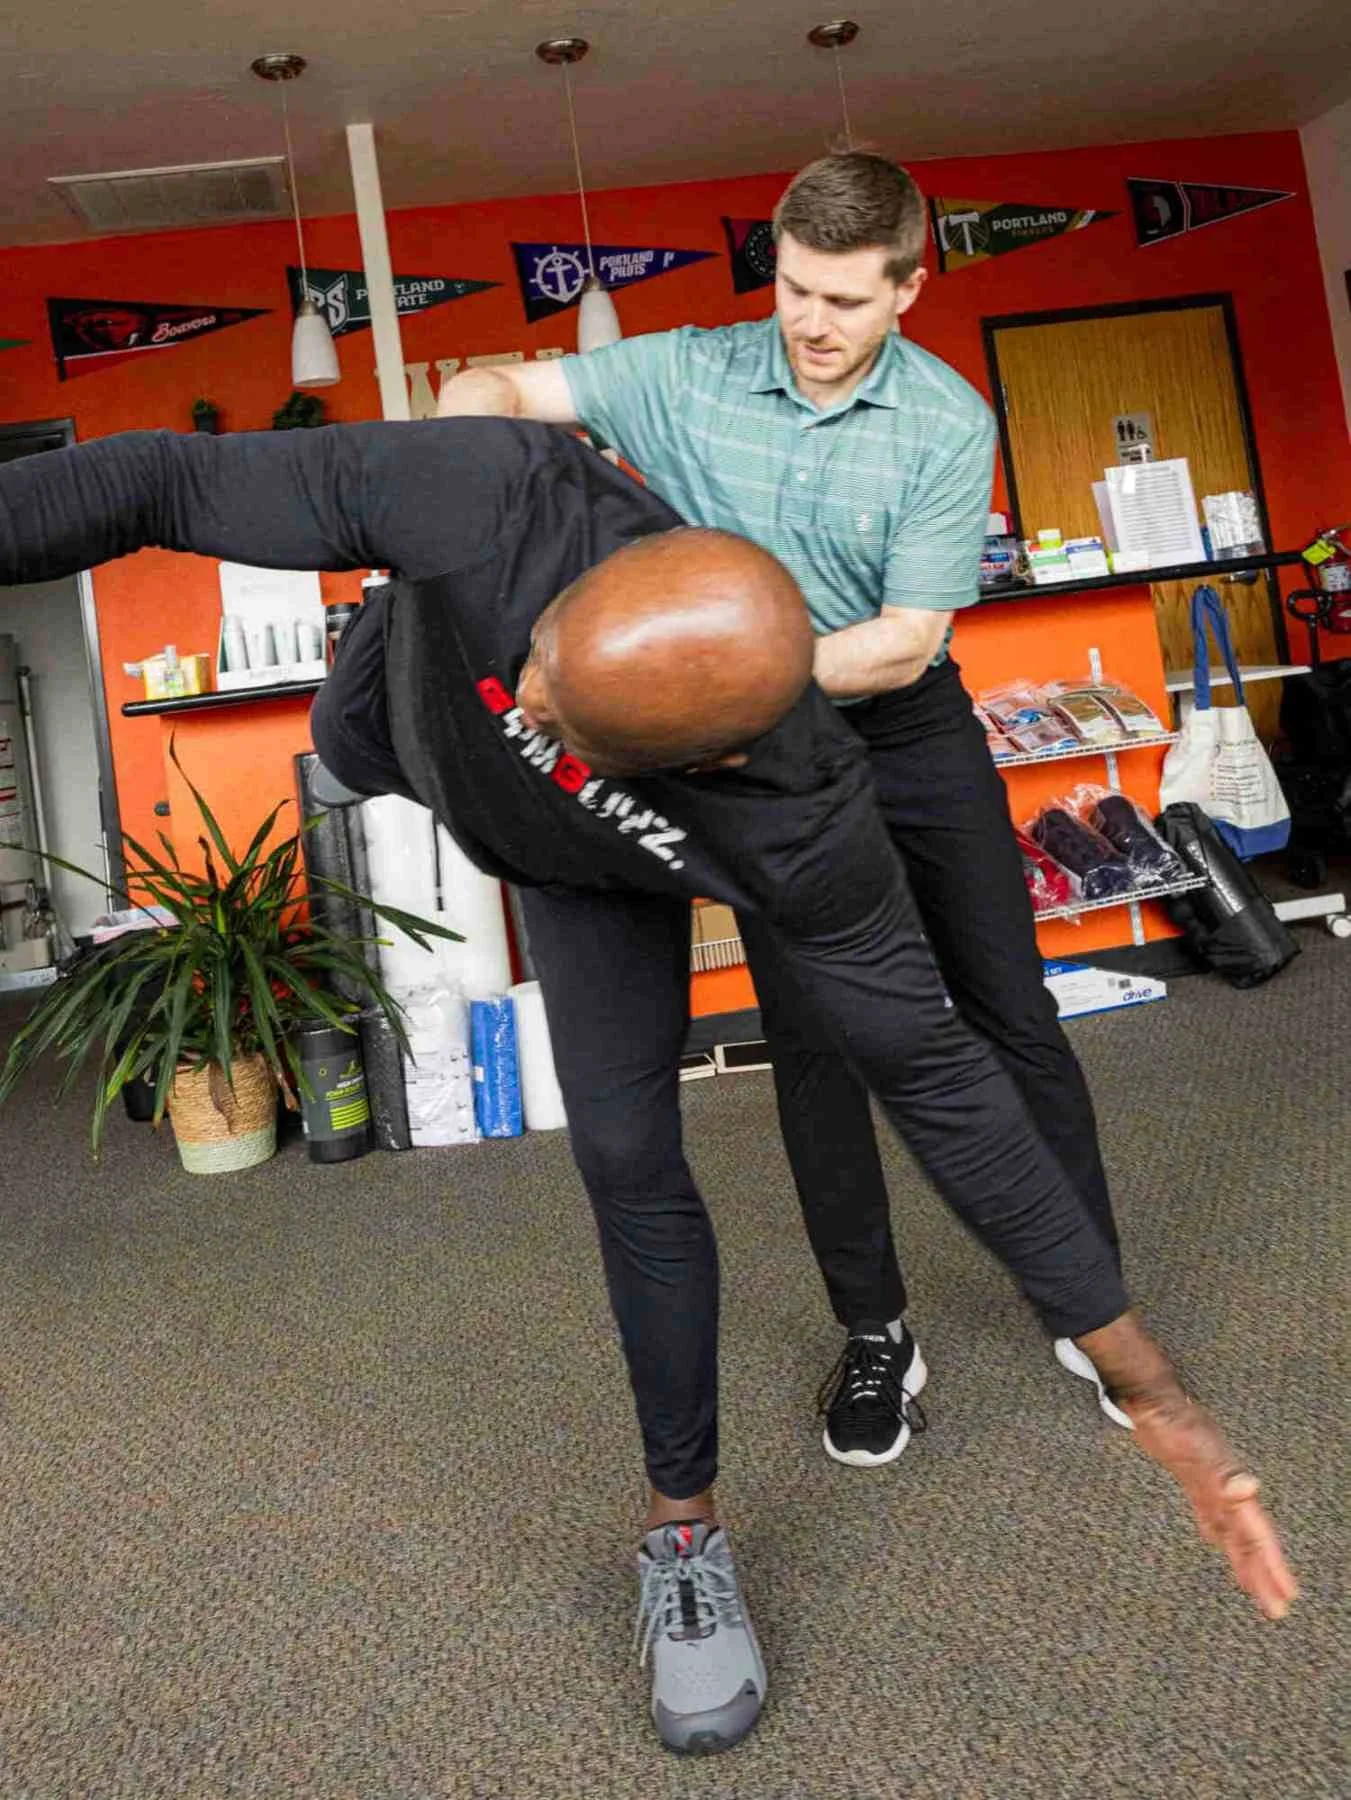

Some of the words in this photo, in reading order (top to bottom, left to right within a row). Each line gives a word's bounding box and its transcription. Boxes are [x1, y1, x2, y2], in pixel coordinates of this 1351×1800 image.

[992, 211, 1067, 231] PORTLAND
[600, 250, 654, 271] PORTLAND
[610, 263, 646, 281] PILOTS
[356, 279, 446, 301] PTLAND
